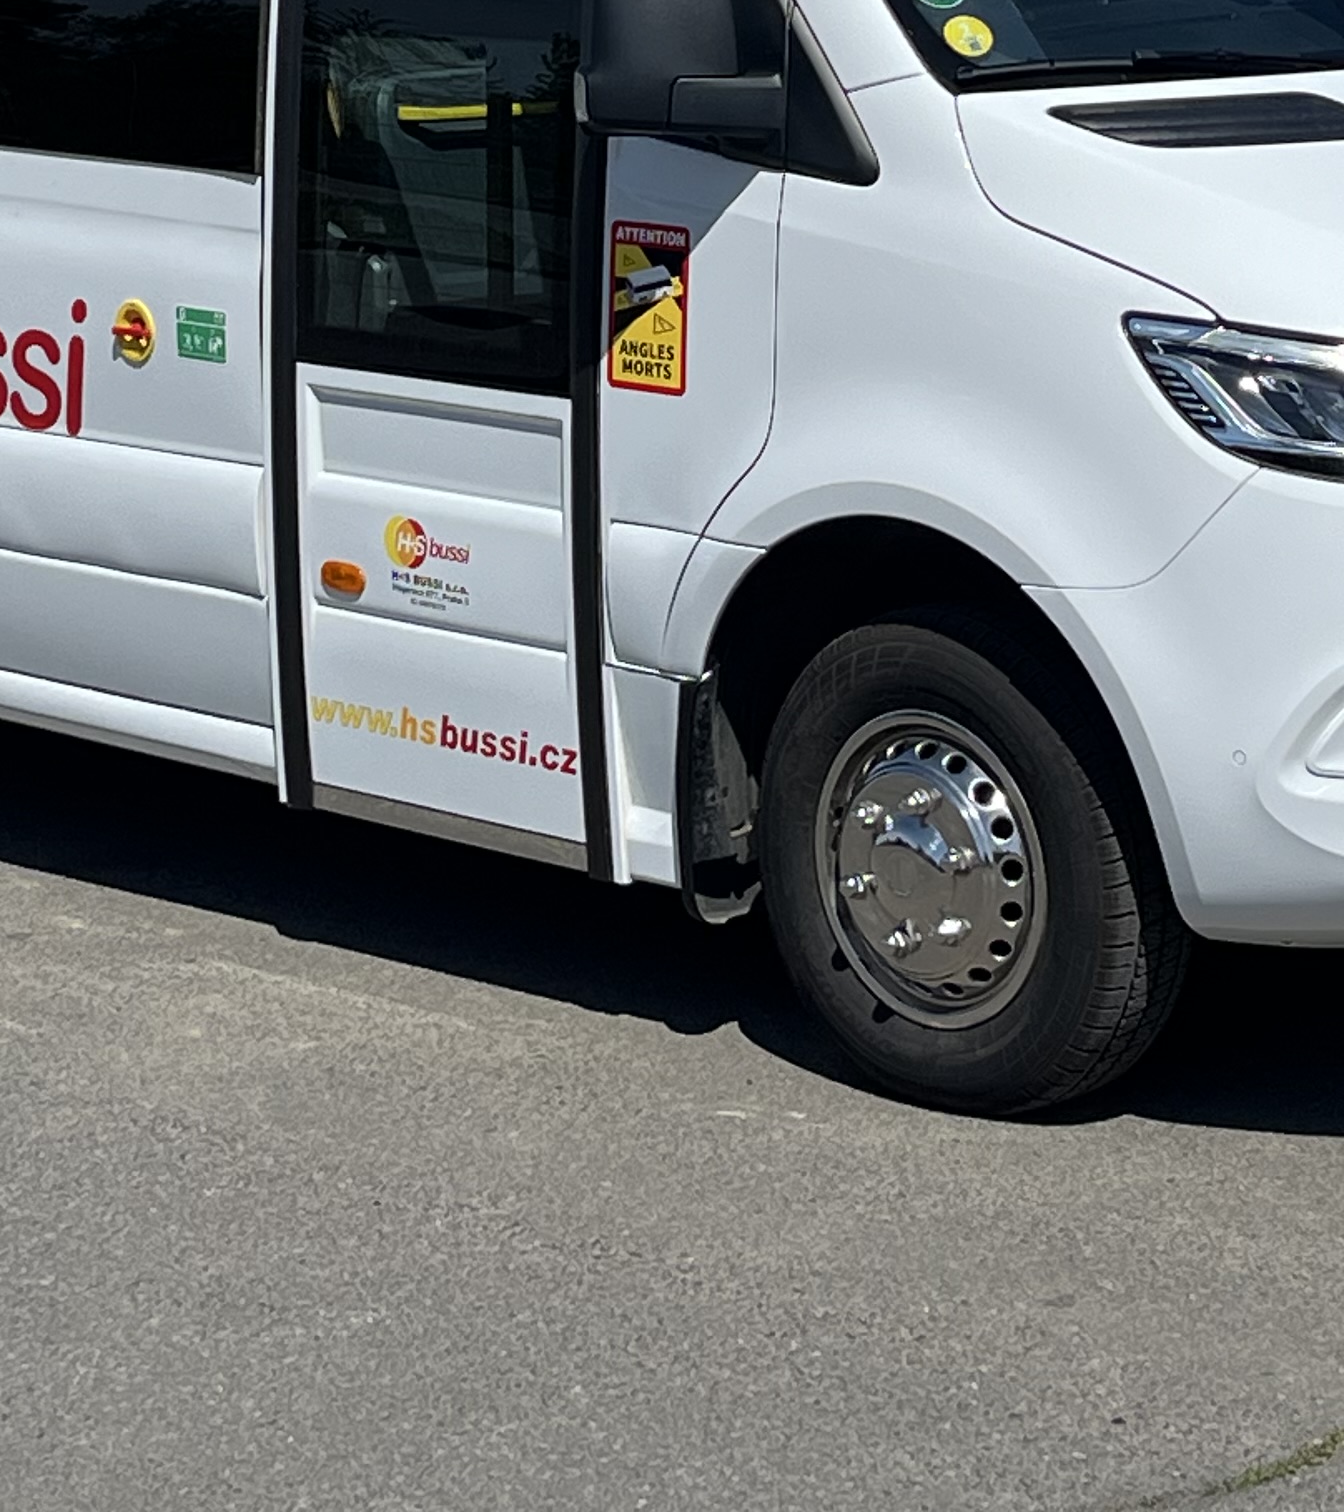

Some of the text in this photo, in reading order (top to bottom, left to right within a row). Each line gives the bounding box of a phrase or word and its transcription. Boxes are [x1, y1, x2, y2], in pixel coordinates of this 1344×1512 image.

[615, 226, 687, 248] ATTENTION
[619, 339, 675, 362] ANGLES
[621, 357, 672, 380] MORTS
[429, 537, 471, 565] bussi
[310, 695, 578, 776] www.hsbussi.cz
